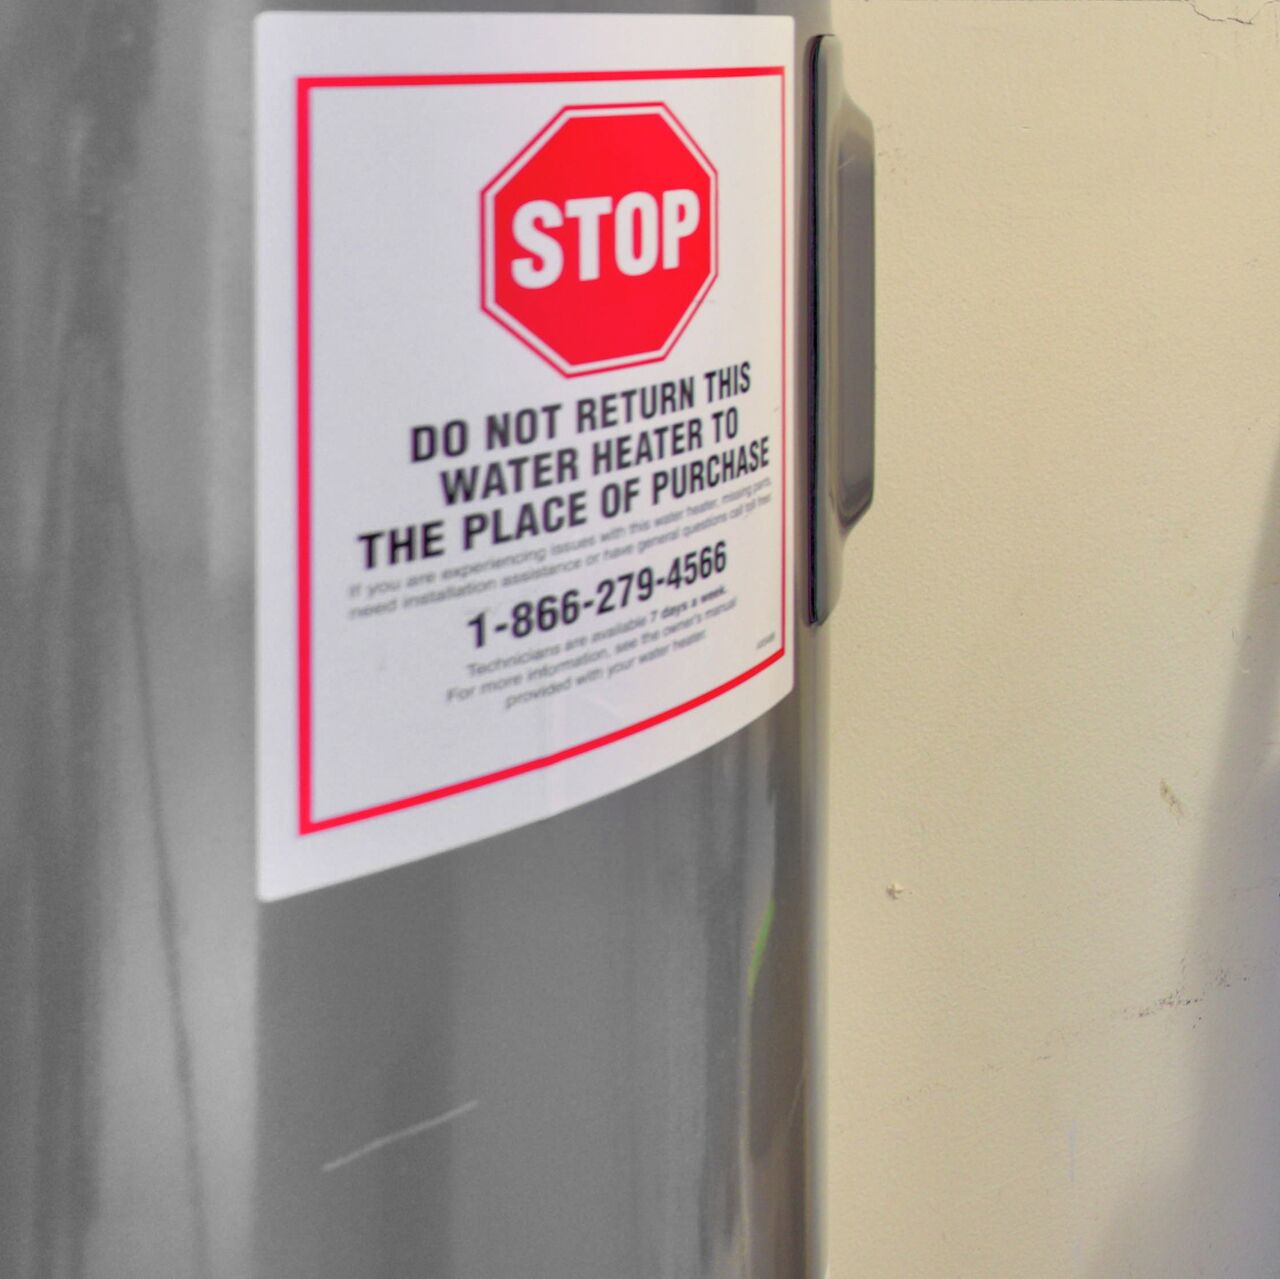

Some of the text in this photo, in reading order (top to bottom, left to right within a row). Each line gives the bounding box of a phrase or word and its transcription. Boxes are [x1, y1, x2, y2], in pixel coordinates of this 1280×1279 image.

[511, 188, 700, 290] STOP
[411, 361, 751, 463] DO NOT RETURN THIS
[440, 407, 738, 506] WATER HEATER TO
[357, 435, 770, 570] THE PLACE OF PURCHASE
[349, 583, 362, 598] If
[366, 581, 401, 598] you
[405, 572, 436, 588] are
[441, 548, 546, 578] experiencing
[552, 536, 596, 556] issues
[600, 527, 626, 543] with
[629, 520, 650, 535] this
[654, 510, 684, 528] water
[350, 599, 398, 618] need
[403, 579, 498, 608] installation
[501, 556, 581, 587] assistance
[585, 554, 601, 567] or
[603, 542, 635, 561] have
[637, 529, 680, 554] general
[683, 513, 728, 537] questions
[730, 506, 744, 521] call
[468, 541, 727, 649] 1-866-279-4566
[446, 686, 476, 704] For
[479, 673, 524, 695] more
[615, 638, 638, 654] see
[641, 630, 660, 644] the
[663, 613, 703, 637] owner's
[705, 596, 737, 618] manual
[466, 644, 561, 676] Technicians
[565, 636, 587, 651] are
[591, 616, 647, 644] available
[650, 610, 658, 622] 7
[661, 601, 687, 620] days
[691, 598, 698, 608] a
[505, 677, 573, 710] provided
[576, 668, 604, 686] with
[607, 657, 636, 678] your
[639, 644, 671, 663] water
